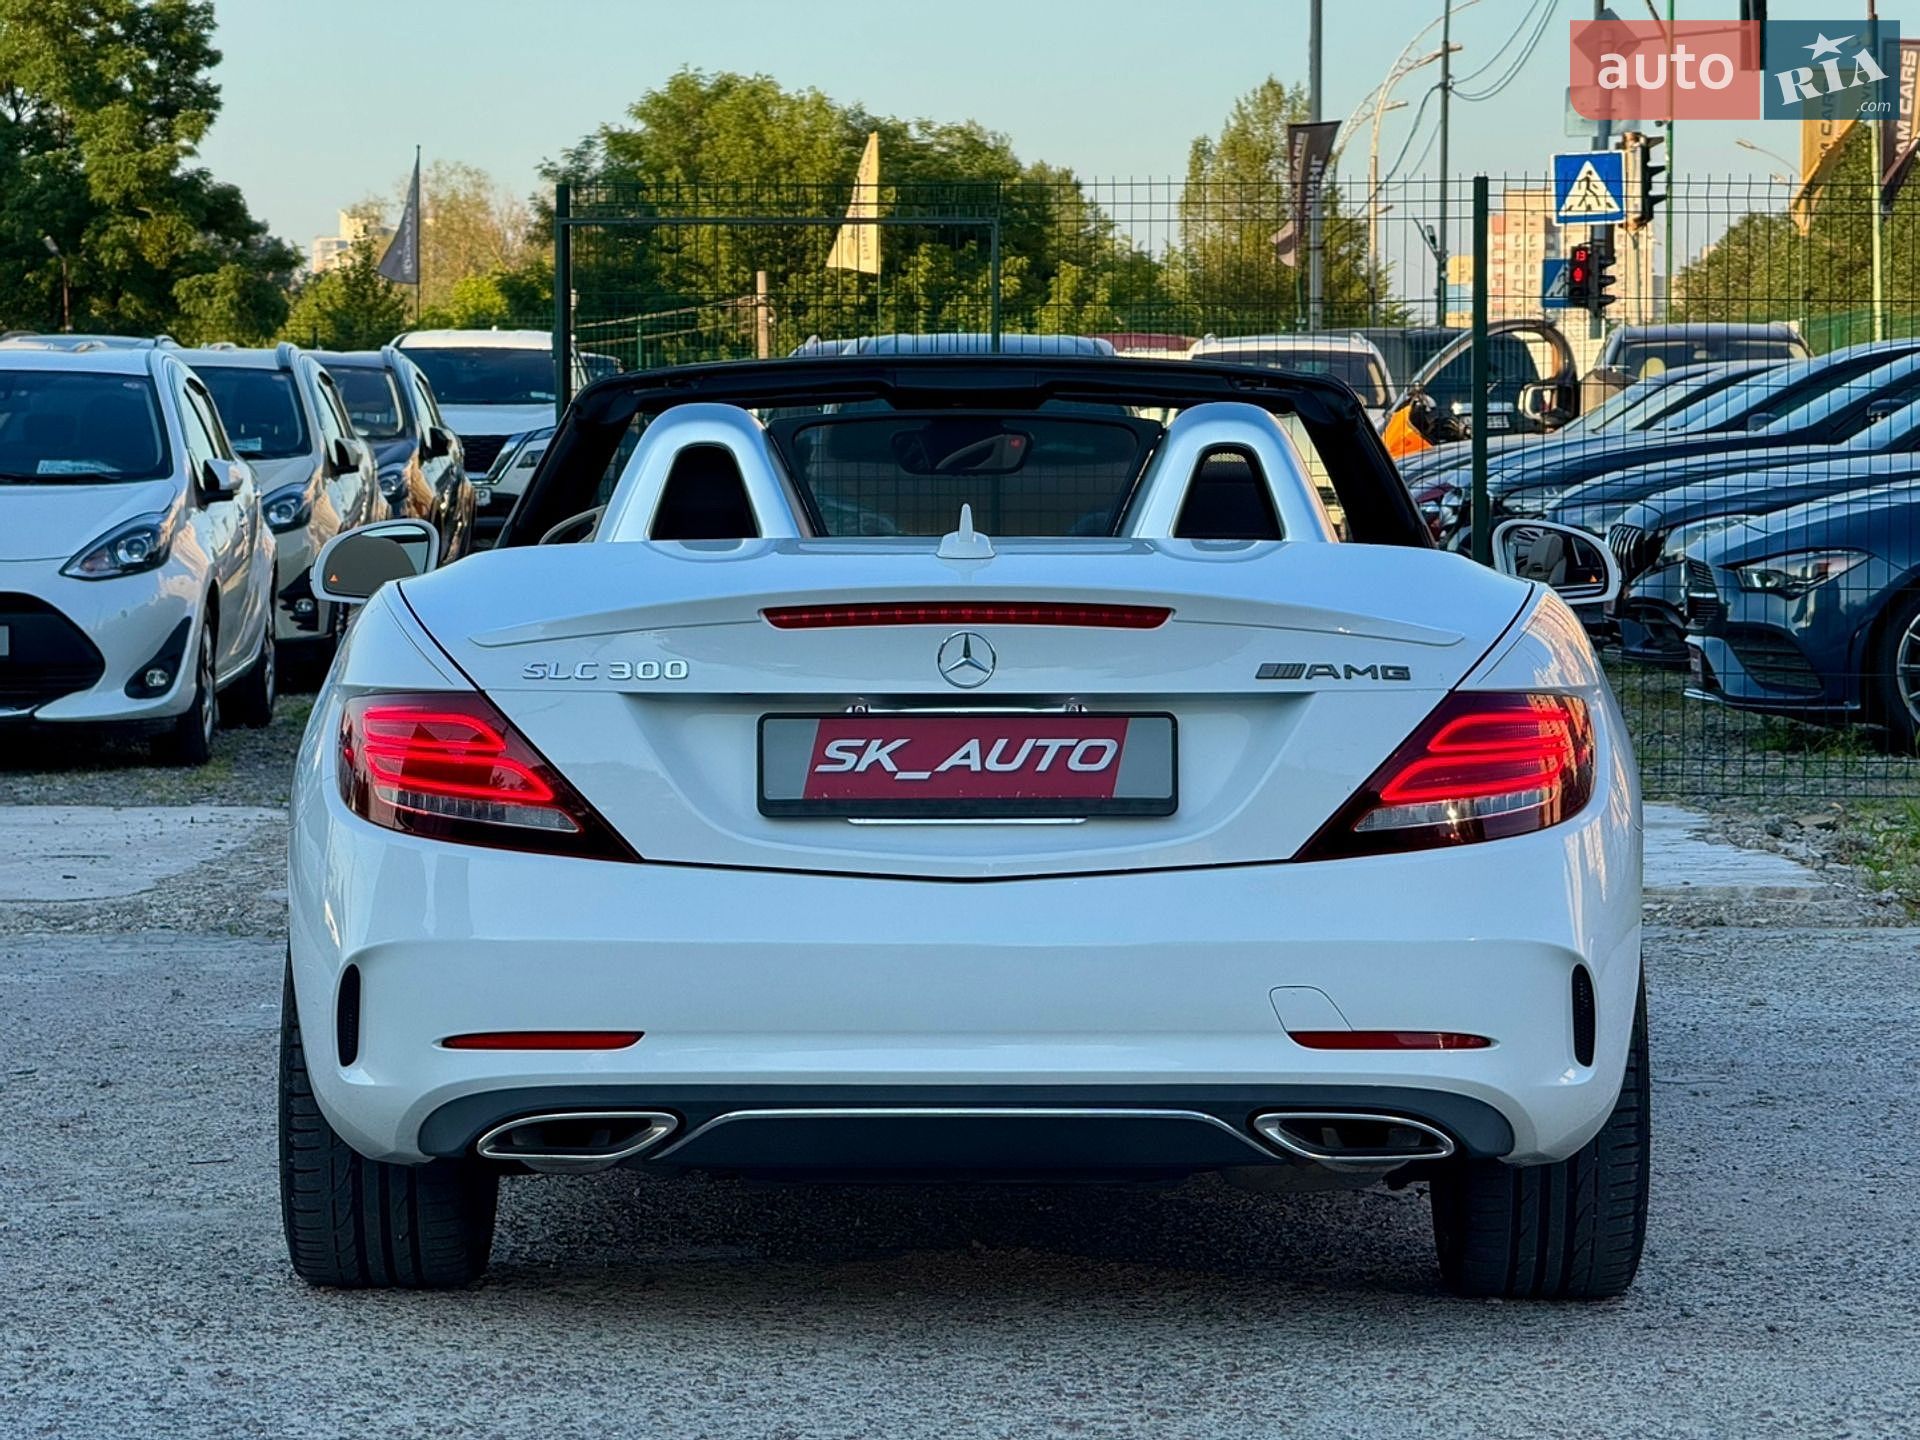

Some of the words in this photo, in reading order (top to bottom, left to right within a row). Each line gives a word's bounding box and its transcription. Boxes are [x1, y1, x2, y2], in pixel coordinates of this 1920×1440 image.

[522, 662, 599, 680] SLC
[607, 660, 689, 681] 300
[1305, 663, 1411, 681] AMG
[814, 738, 1119, 780] SK_AUTO
